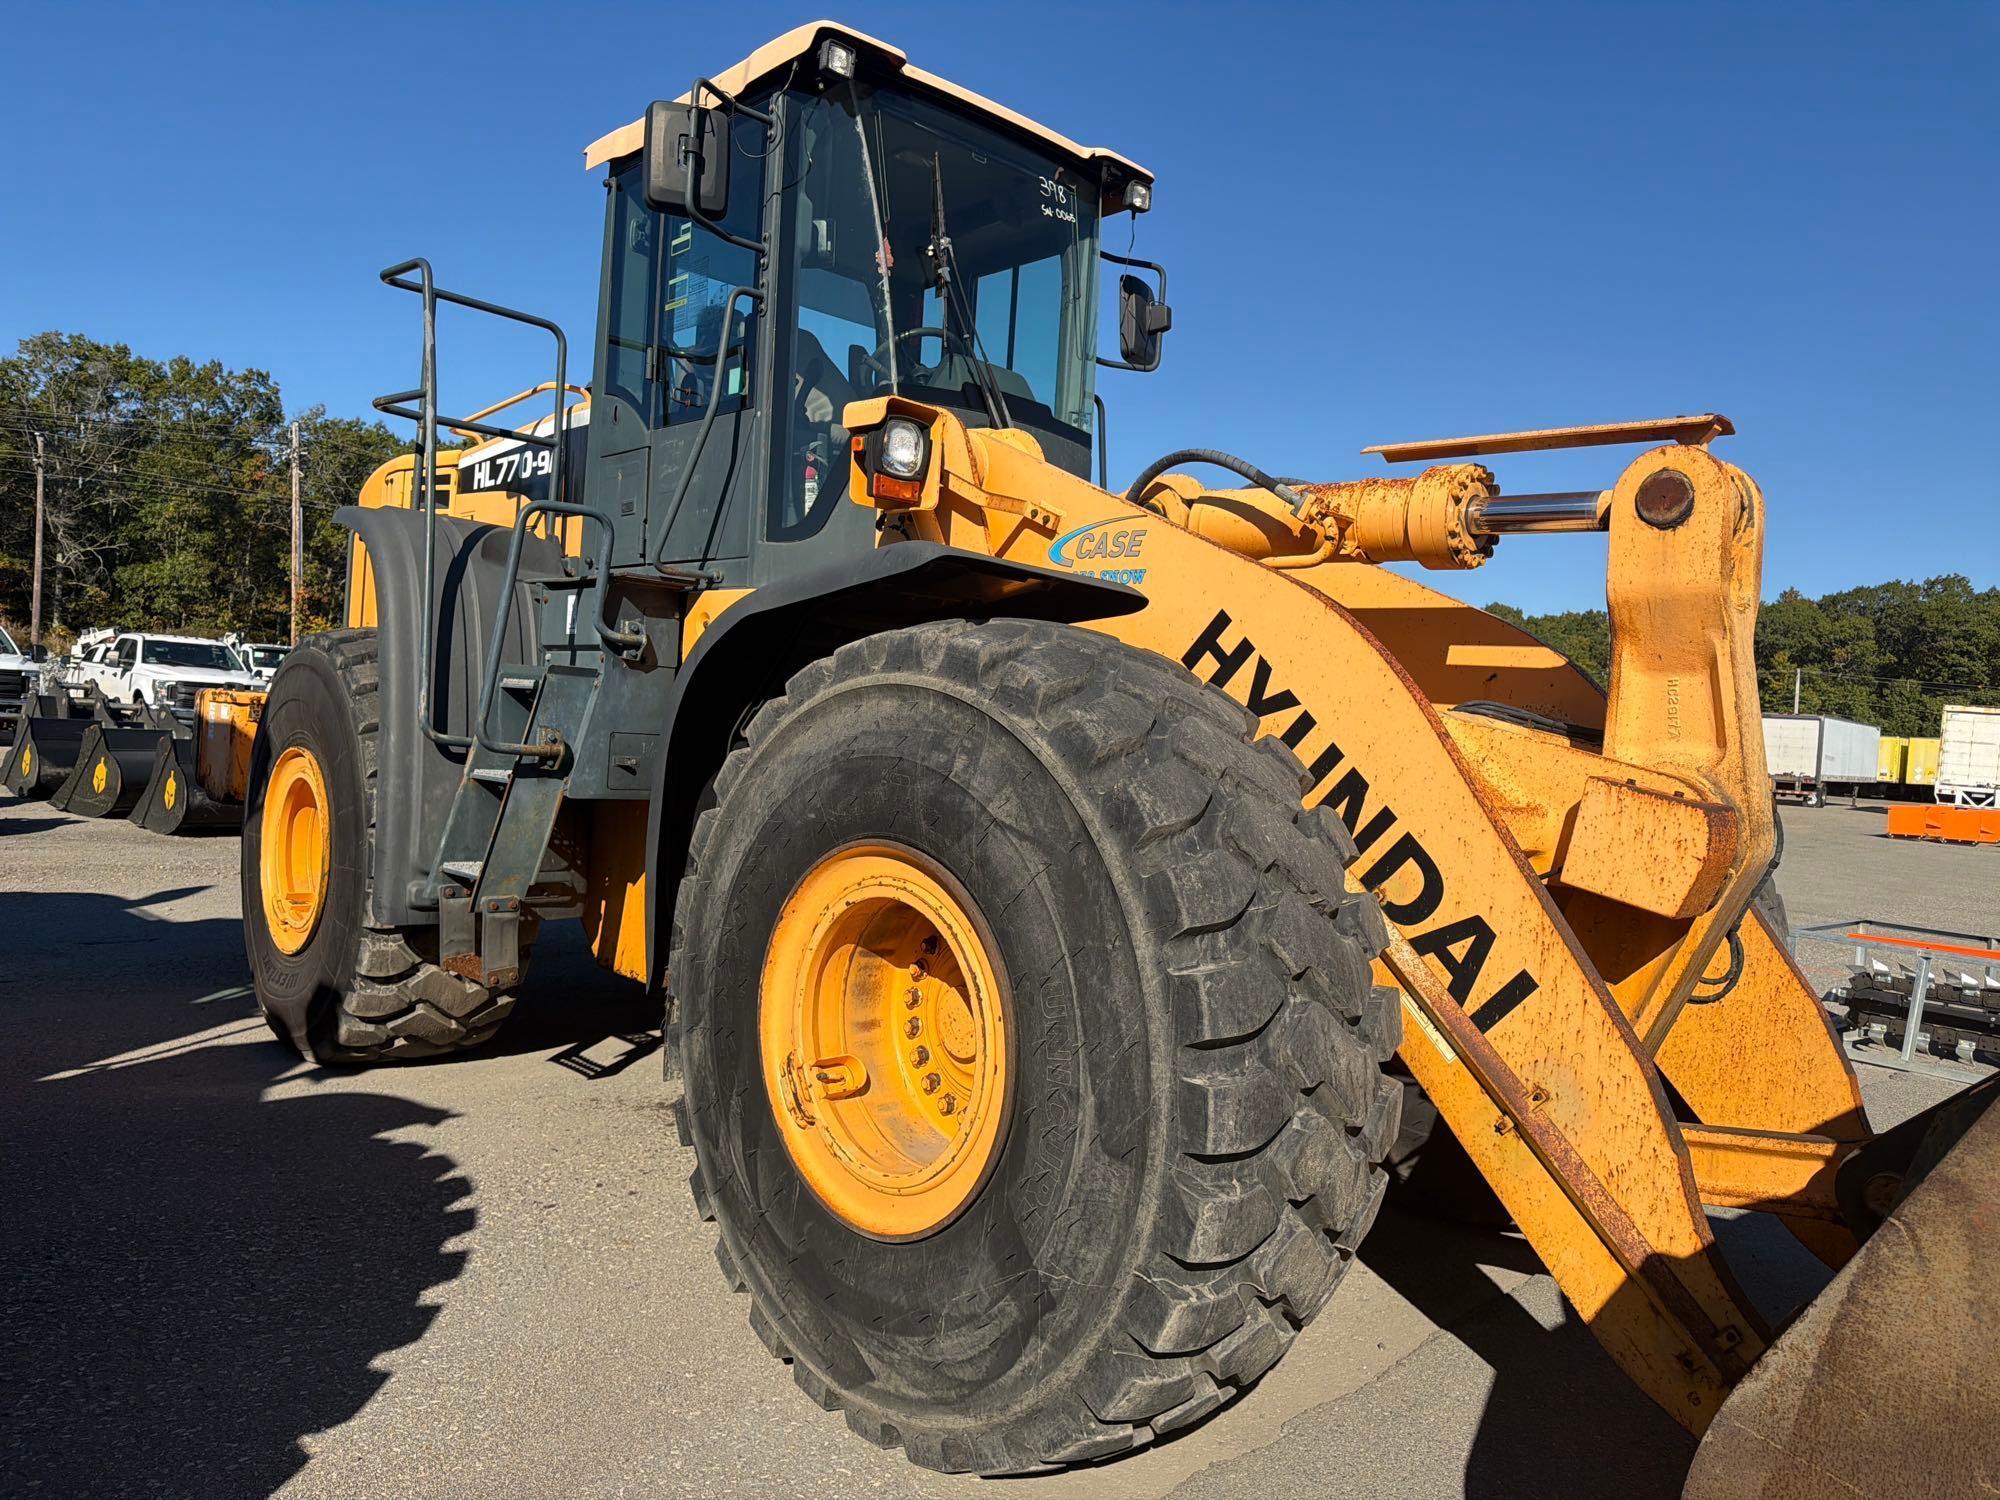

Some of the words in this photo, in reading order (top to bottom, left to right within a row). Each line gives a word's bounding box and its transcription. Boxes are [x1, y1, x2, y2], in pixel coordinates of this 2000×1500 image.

[1039, 176, 1067, 203] 398
[473, 450, 553, 490] HL770-9
[1076, 530, 1148, 559] CASE
